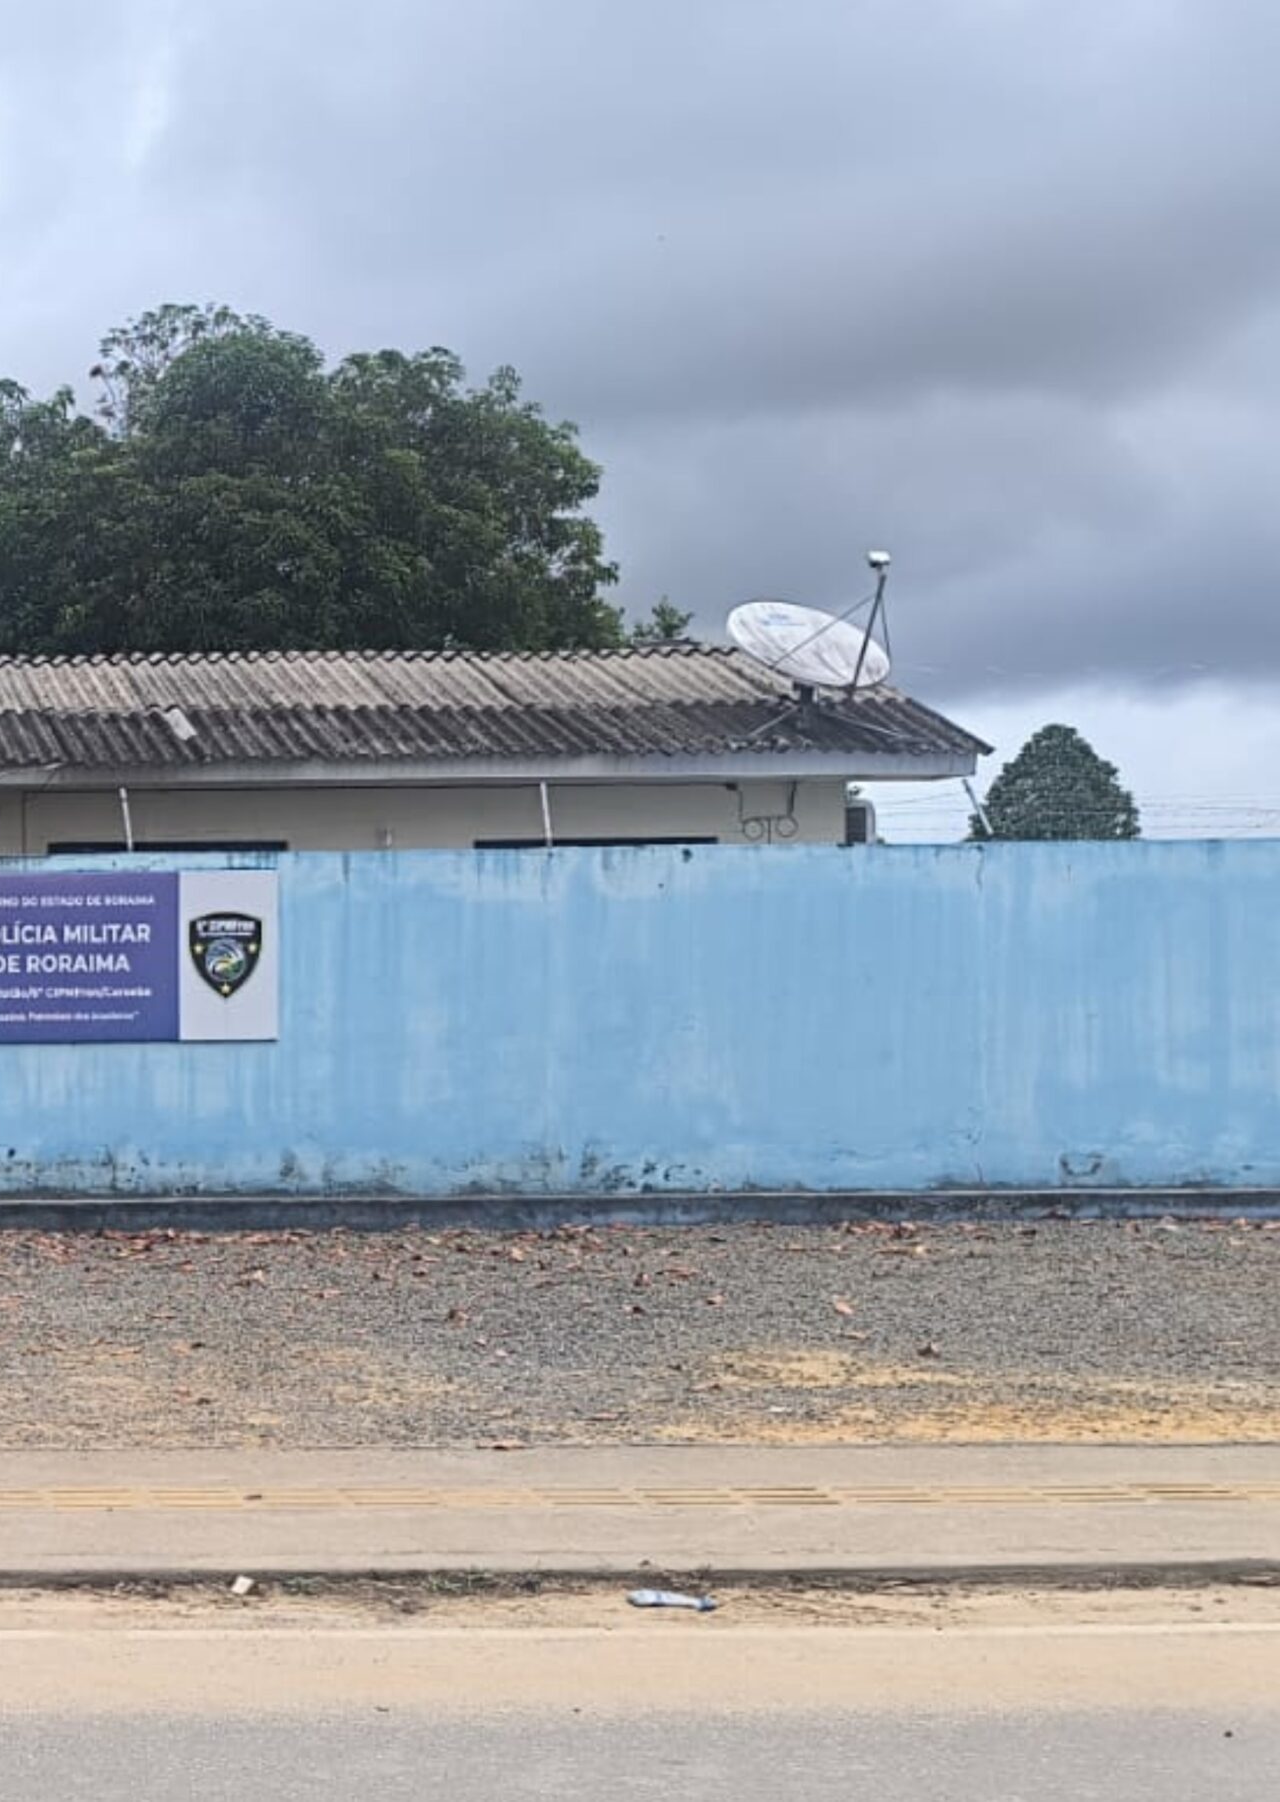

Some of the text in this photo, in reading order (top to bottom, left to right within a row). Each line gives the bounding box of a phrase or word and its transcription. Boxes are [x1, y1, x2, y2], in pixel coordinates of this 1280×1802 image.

[22, 896, 37, 907] DO
[86, 895, 102, 906] DE
[63, 923, 151, 943] MILITAR
[26, 953, 131, 973] RORAIMA
